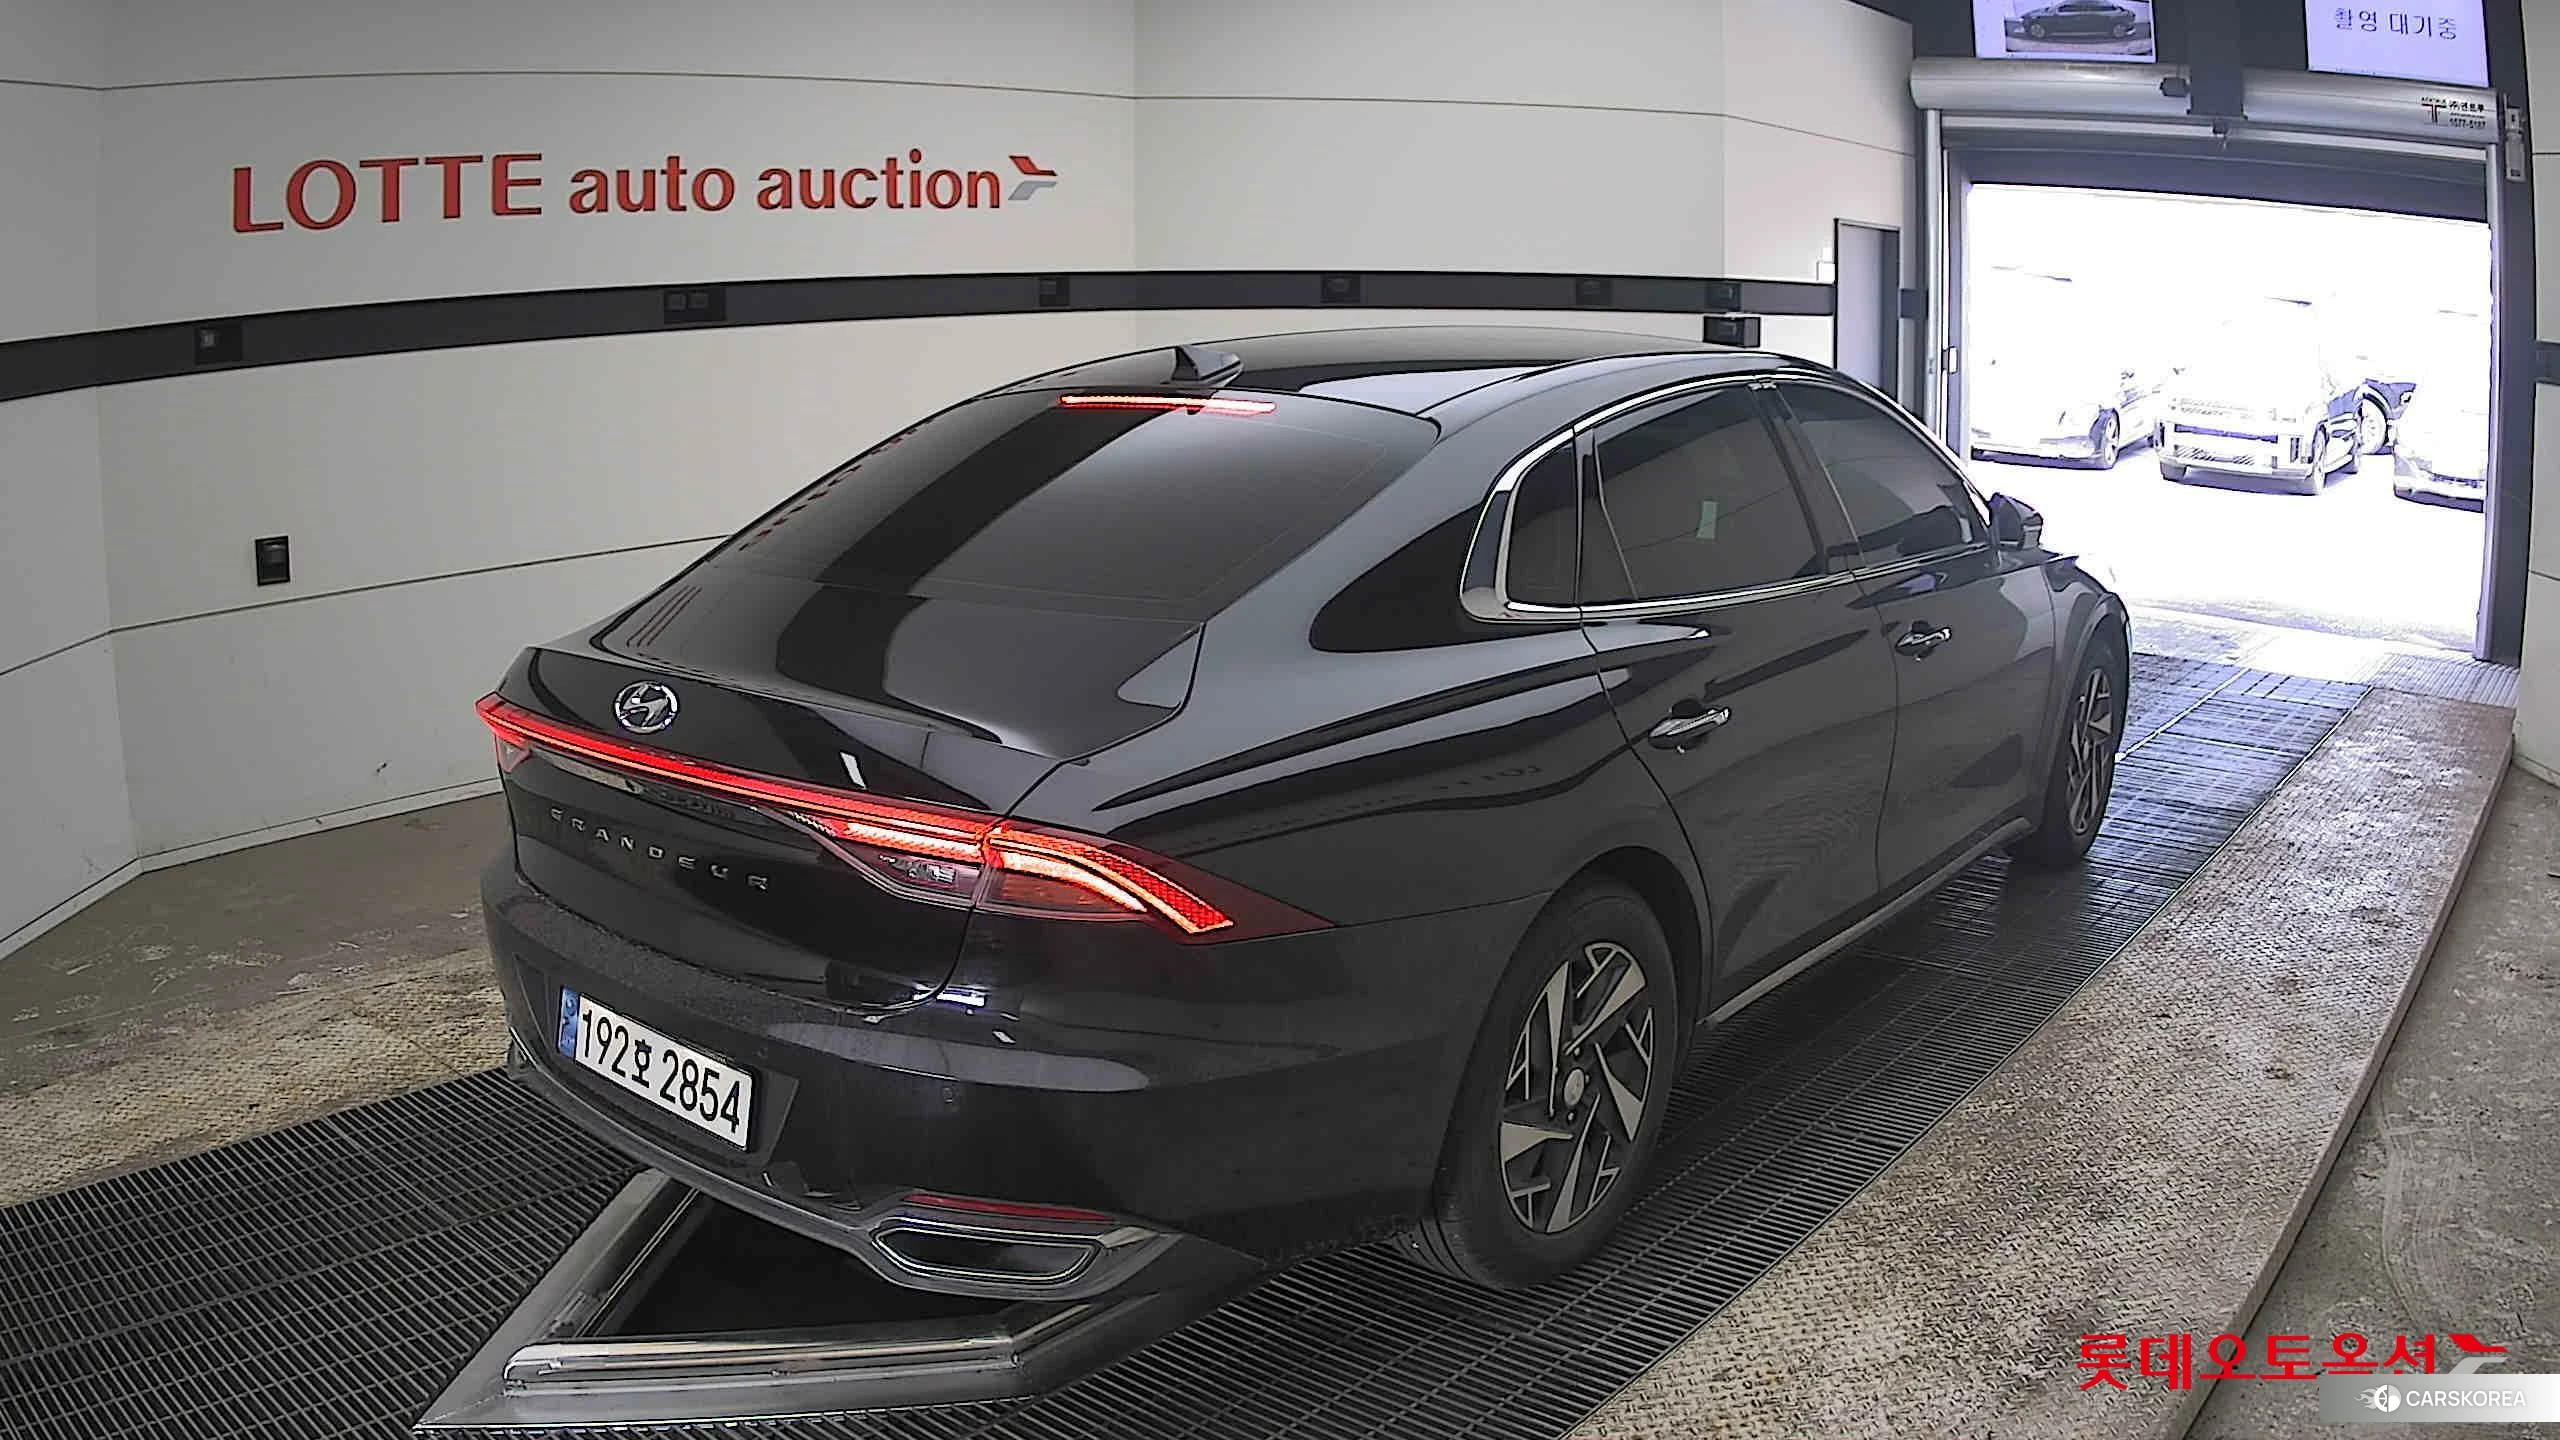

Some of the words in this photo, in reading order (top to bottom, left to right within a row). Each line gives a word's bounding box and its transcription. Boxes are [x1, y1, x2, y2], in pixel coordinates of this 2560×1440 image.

[2388, 12, 2457, 41] 대기중
[232, 152, 544, 233] LOTTE
[567, 154, 736, 214] auto
[756, 147, 1002, 211] auction
[581, 1008, 653, 1089] 192호
[659, 1048, 741, 1134] 2854
